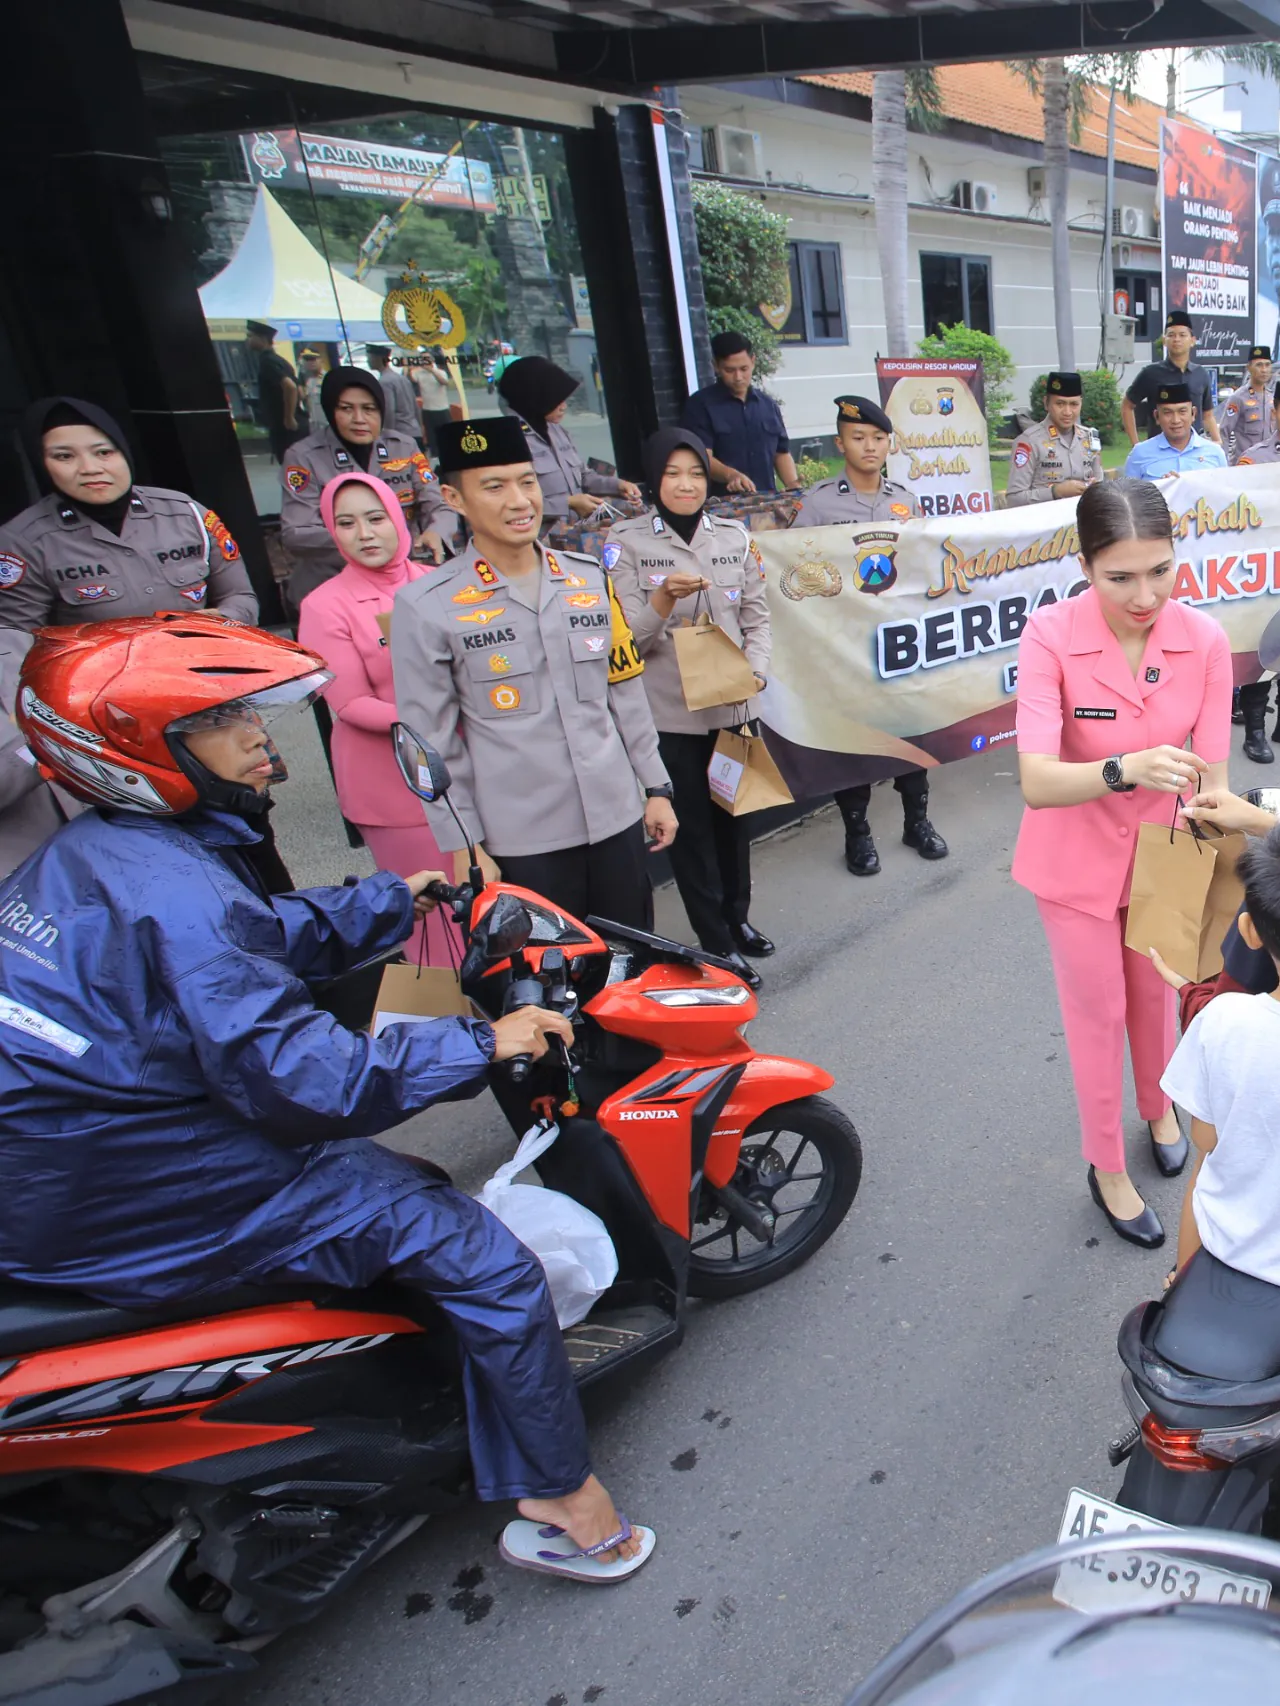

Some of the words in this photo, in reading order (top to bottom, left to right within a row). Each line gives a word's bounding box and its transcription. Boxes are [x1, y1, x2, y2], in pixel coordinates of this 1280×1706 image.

[1183, 200, 1202, 217] BAIK
[1202, 205, 1233, 224] MENJADI
[1183, 220, 1211, 237] ORANG
[1211, 225, 1239, 243] PENTING
[1171, 255, 1188, 269] TAPI
[1188, 257, 1205, 272] JAUH
[1206, 259, 1223, 274] LEBIH
[1224, 262, 1250, 278] PENTING
[1187, 275, 1219, 290] MENJADI
[1188, 291, 1224, 309] ORANG
[1226, 295, 1247, 311] BAIK
[883, 362, 923, 371] KEPOLISIAN
[924, 363, 948, 371] RESOR
[949, 363, 977, 371] MADIUN
[889, 425, 984, 455] Ramadhan
[908, 452, 971, 480] Berkah
[920, 491, 991, 517] RBAGI
[857, 533, 875, 543] JAWA
[875, 532, 895, 541] TIMUR
[56, 563, 110, 581] ICHA
[640, 559, 675, 568] NUNIK
[711, 556, 742, 566] POLRI
[927, 534, 1080, 597] Ramadh
[569, 613, 609, 628] POLRI
[463, 628, 517, 650] KEMAS
[619, 1109, 679, 1121] HONDA
[9, 1428, 112, 1443] COOLED
[1121, 1555, 1201, 1602] 3363
